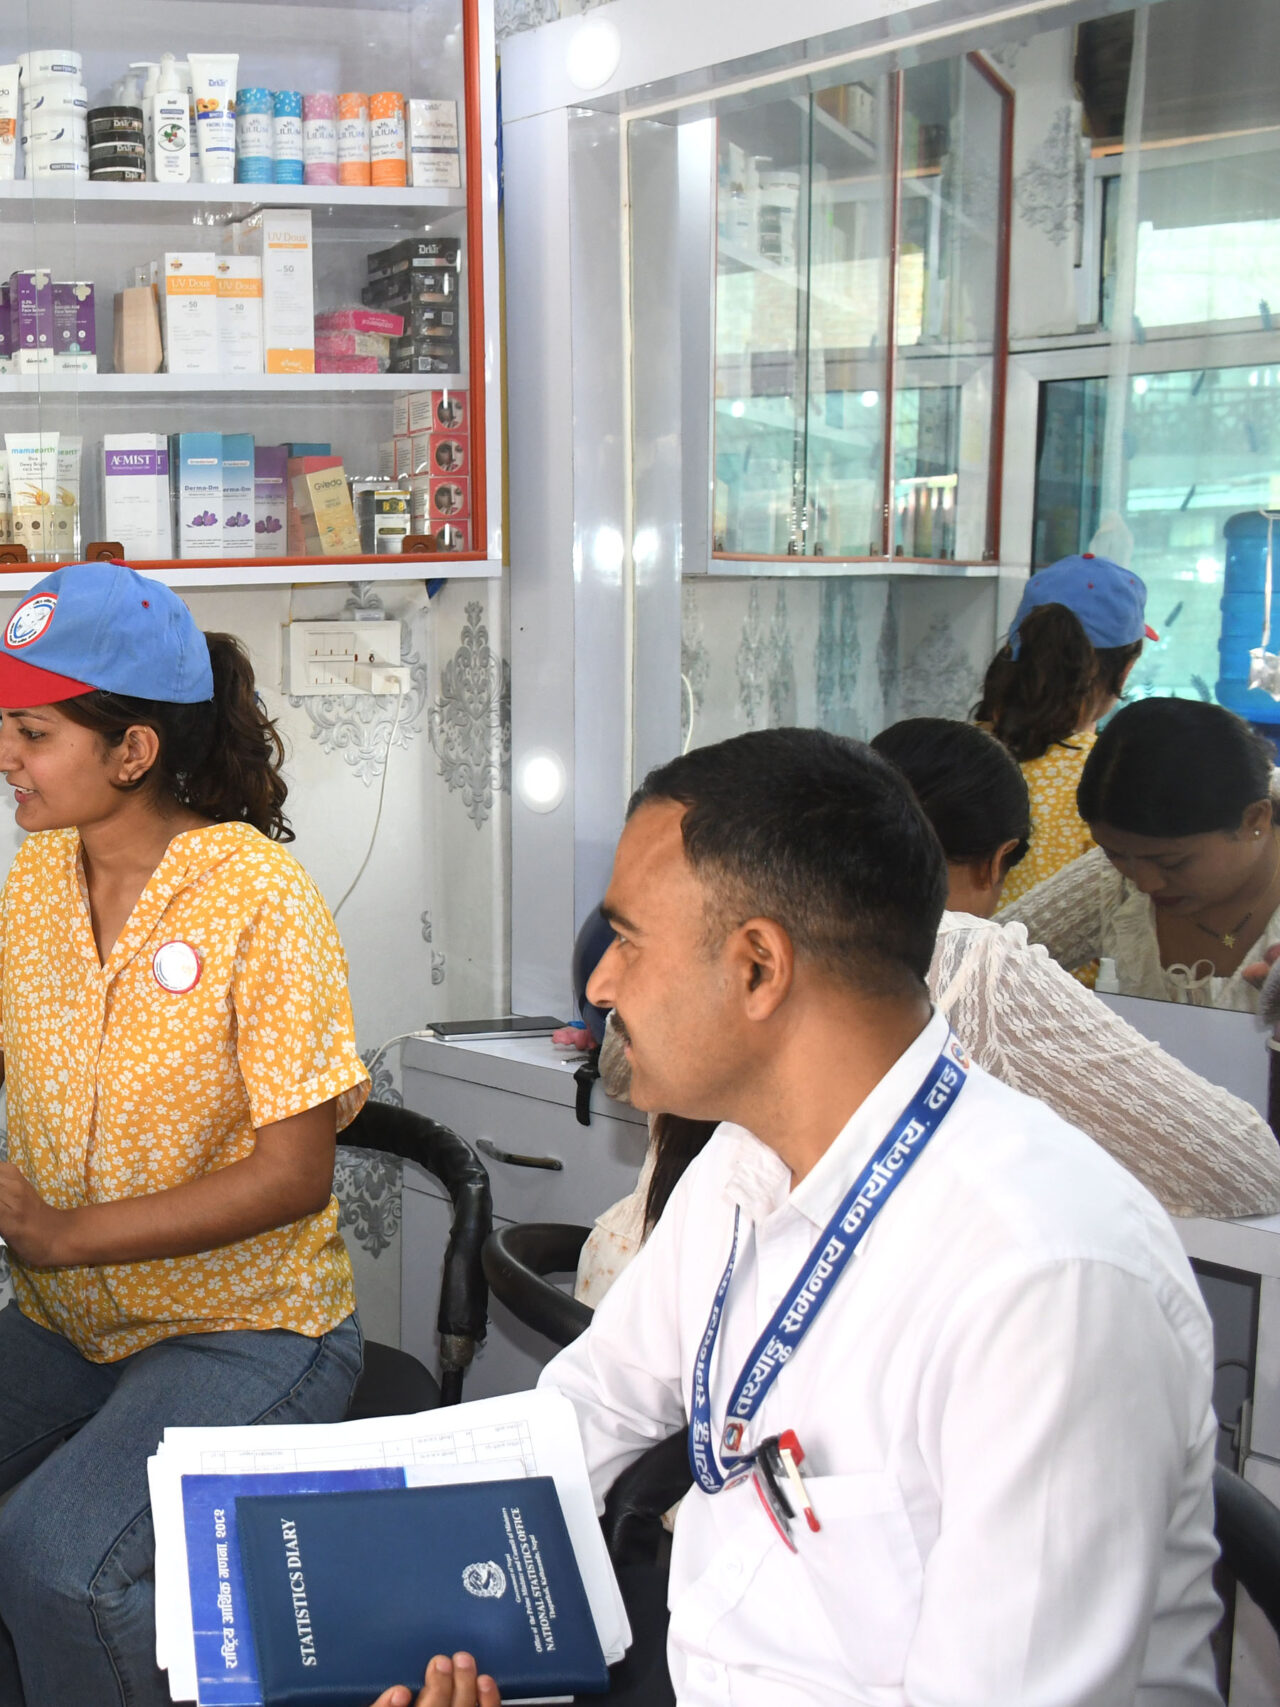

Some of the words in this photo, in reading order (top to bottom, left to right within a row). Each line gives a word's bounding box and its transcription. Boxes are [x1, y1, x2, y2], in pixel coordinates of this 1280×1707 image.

[283, 265, 295, 273] 50
[189, 301, 198, 309] 50
[11, 446, 56, 455] mamaearth
[780, 1236, 846, 1334] समन्वय
[923, 1065, 959, 1112] दाङ
[501, 1507, 512, 1532] Ministers
[510, 1507, 528, 1542] OFFICE
[281, 1517, 303, 1568] DIARY
[509, 1539, 520, 1560] Council
[504, 1553, 514, 1567] Nepal
[520, 1543, 541, 1597] STATISTICS
[510, 1573, 522, 1603] Government
[518, 1573, 528, 1597] Minister
[217, 1581, 234, 1624] आर्थिक
[524, 1597, 534, 1614] Prime
[289, 1571, 318, 1667] STATISTICS
[535, 1598, 557, 1652] NATIONAL
[533, 1634, 543, 1653] Office
